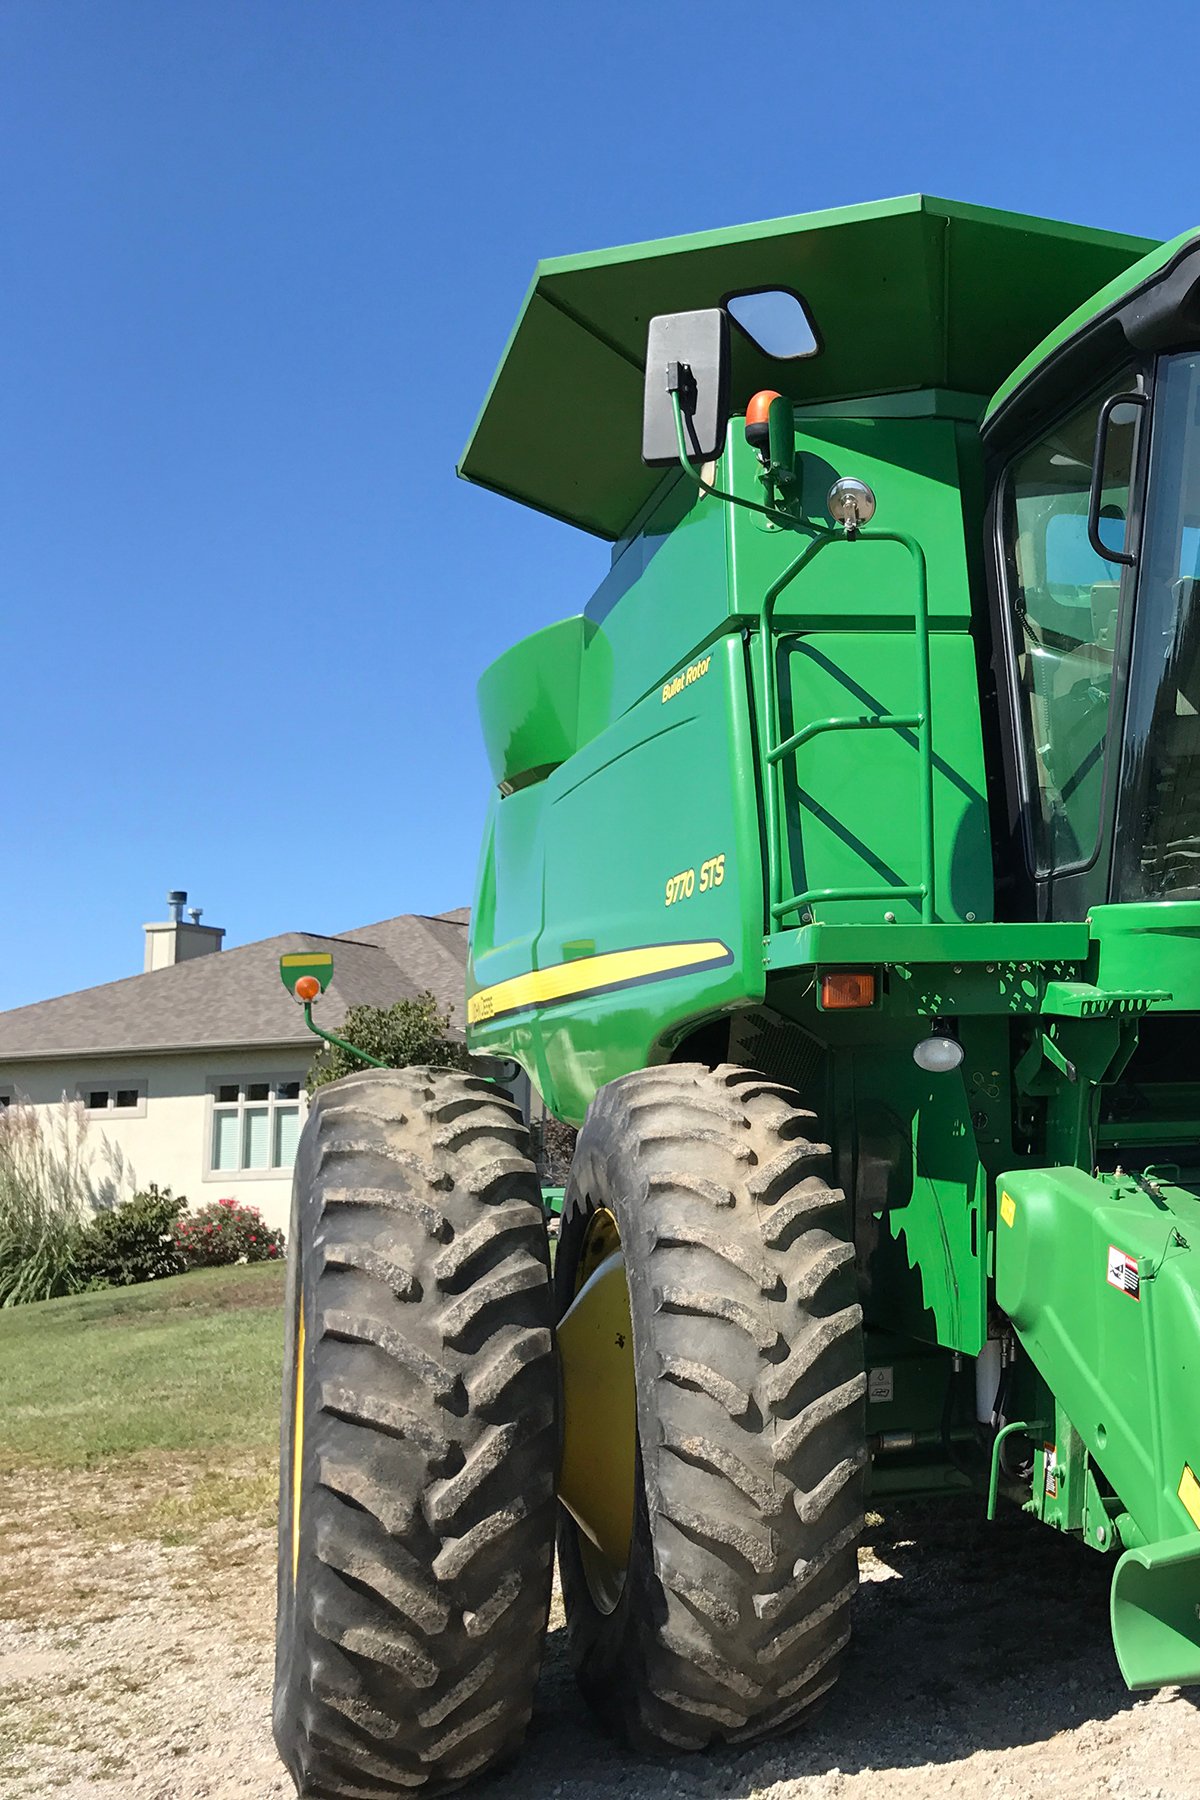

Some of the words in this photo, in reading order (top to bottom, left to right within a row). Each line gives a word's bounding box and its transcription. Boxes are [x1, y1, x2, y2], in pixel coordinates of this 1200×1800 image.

[661, 672, 685, 704] Bullet
[685, 655, 711, 687] Rotor
[665, 868, 695, 907] 9770
[699, 853, 725, 892] STS
